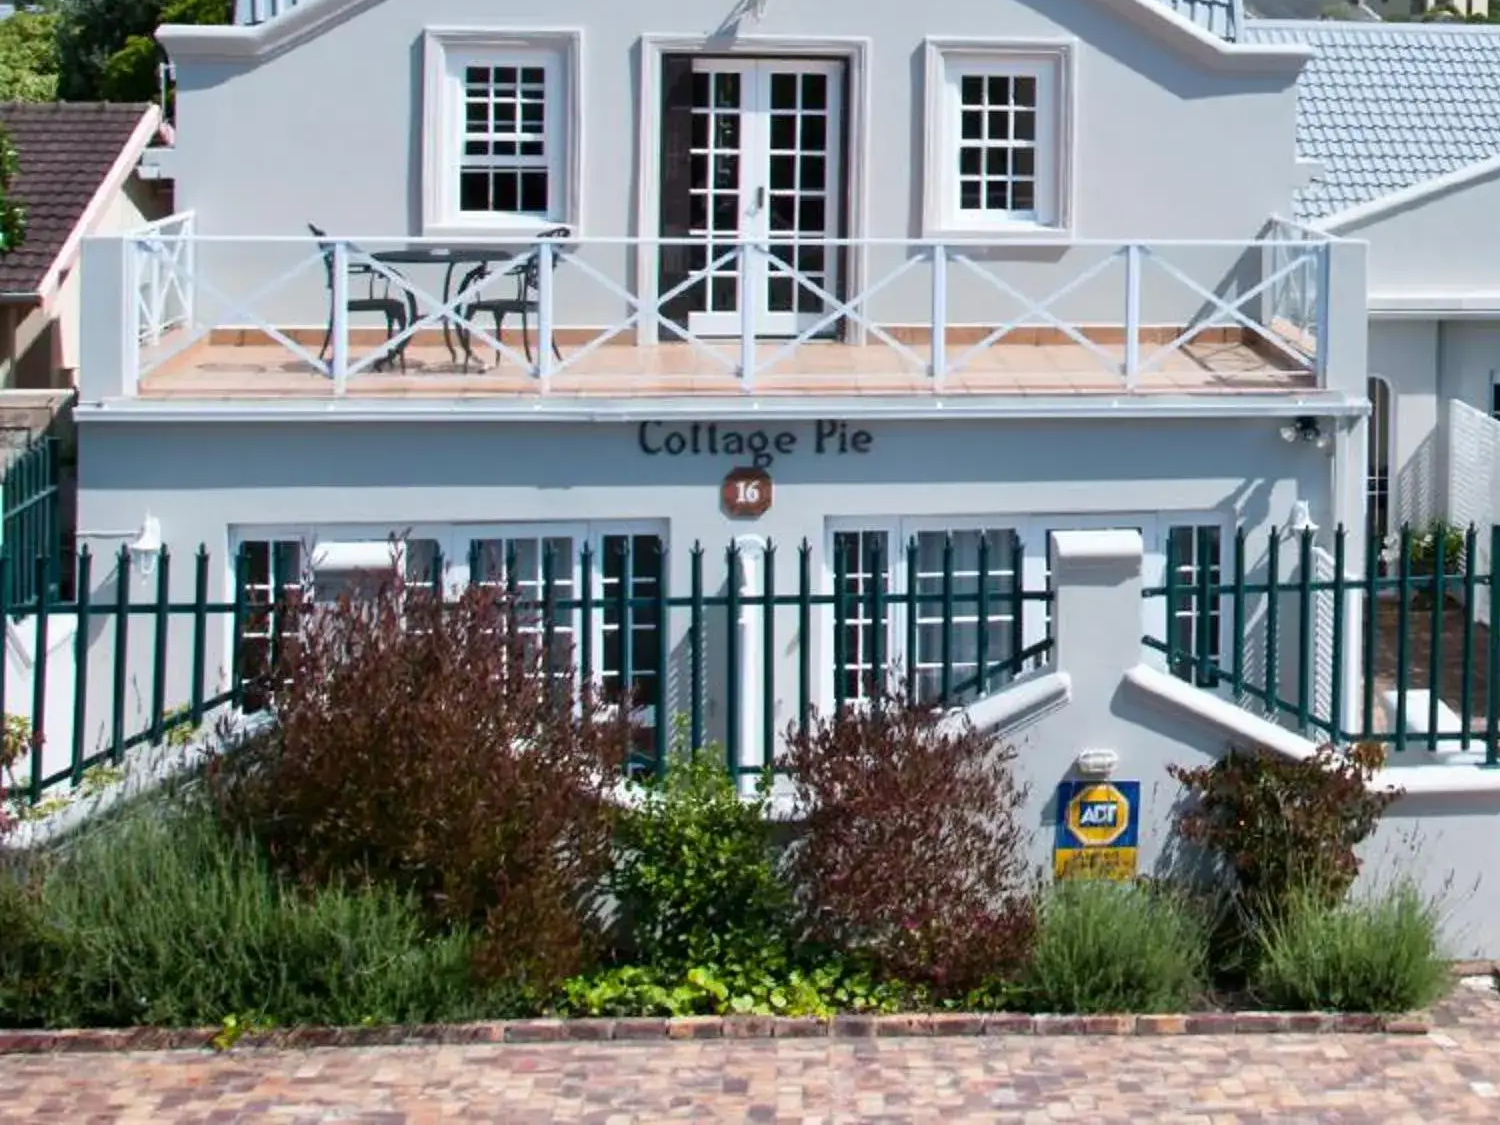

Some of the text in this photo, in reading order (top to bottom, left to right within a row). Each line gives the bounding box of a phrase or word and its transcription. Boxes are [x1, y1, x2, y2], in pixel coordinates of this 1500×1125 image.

[815, 419, 873, 454] Pie
[735, 481, 760, 503] 16
[1080, 803, 1117, 824] ADT
